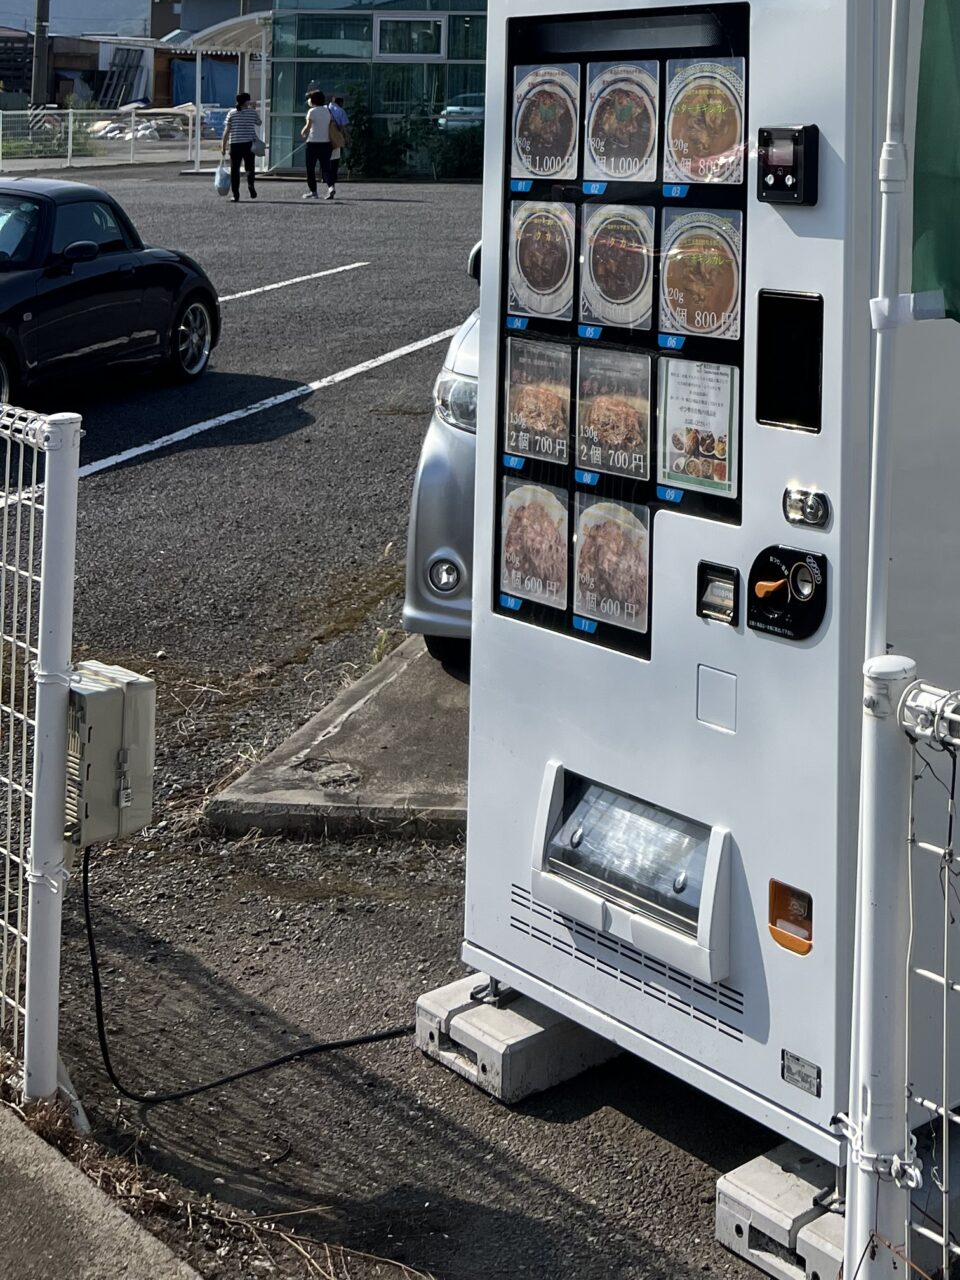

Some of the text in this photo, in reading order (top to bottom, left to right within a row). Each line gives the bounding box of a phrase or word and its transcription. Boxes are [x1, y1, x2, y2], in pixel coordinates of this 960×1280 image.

[590, 183, 600, 193] 02
[671, 186, 681, 197] 03
[585, 327, 595, 337] 05
[667, 337, 677, 348] 06
[665, 489, 675, 500] 09
